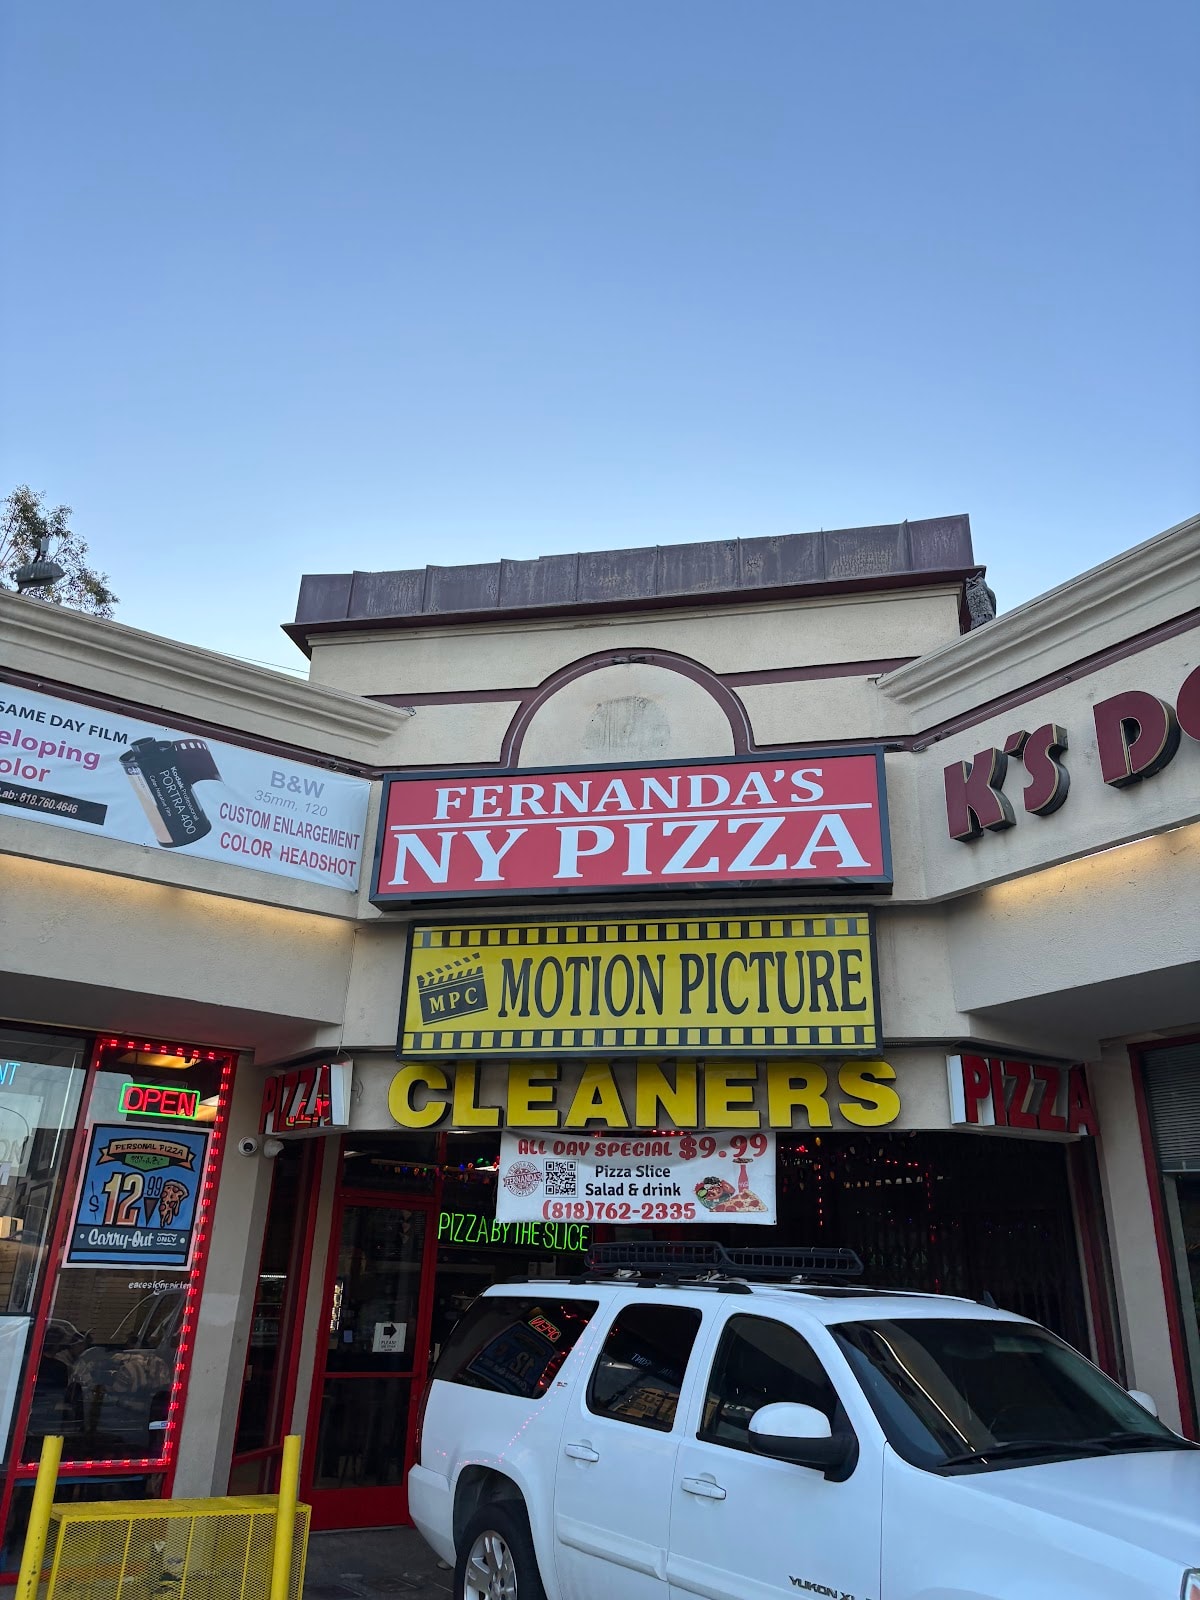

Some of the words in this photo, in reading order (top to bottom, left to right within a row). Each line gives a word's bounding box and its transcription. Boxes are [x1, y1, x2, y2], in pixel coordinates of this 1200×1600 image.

[50, 714, 85, 732] DAY
[88, 724, 128, 744] FILM
[170, 766, 184, 790] Kodak
[270, 770, 325, 798] B&W
[944, 722, 1069, 842] K'S
[20, 793, 78, 813] 818.760.4646
[160, 769, 186, 814] PORTRA
[181, 813, 197, 835] 400
[254, 790, 298, 811] 35mm,
[305, 802, 328, 816] 120
[433, 768, 824, 820] FERNANDA'S
[220, 803, 271, 830] CUSTOM
[273, 816, 360, 850] ENLARGEMENT
[220, 832, 272, 859] COLOR
[279, 845, 356, 877] HEADSHOT
[388, 828, 528, 885] NY
[553, 813, 871, 879] PIZZA
[498, 953, 666, 1018] MOTION
[679, 949, 867, 1015] PICTURE
[429, 987, 478, 1014] MPC
[124, 1087, 196, 1116] OPEN
[258, 1065, 332, 1135] PIZZA
[388, 1060, 901, 1129] CLEANERS
[956, 1051, 1101, 1136] PIZZA
[115, 1143, 156, 1151] PERSONAL
[159, 1144, 184, 1157] PIZZA
[518, 1138, 547, 1155] ALL
[553, 1140, 590, 1157] DAY
[594, 1141, 673, 1157] SPECIAL
[679, 1133, 768, 1160] $9.99
[595, 1165, 634, 1178] Pizza
[636, 1165, 671, 1178] Slice
[585, 1183, 626, 1196] Salad
[628, 1183, 639, 1196] &
[642, 1183, 681, 1196] drink
[542, 1199, 696, 1220] (818)762-2335
[88, 1228, 154, 1249] Carry-Out
[438, 1213, 489, 1243] PIZZA
[491, 1219, 511, 1243] BY
[515, 1222, 540, 1245] THE
[542, 1222, 589, 1251] SLICE
[788, 1575, 838, 1599] YUKON
